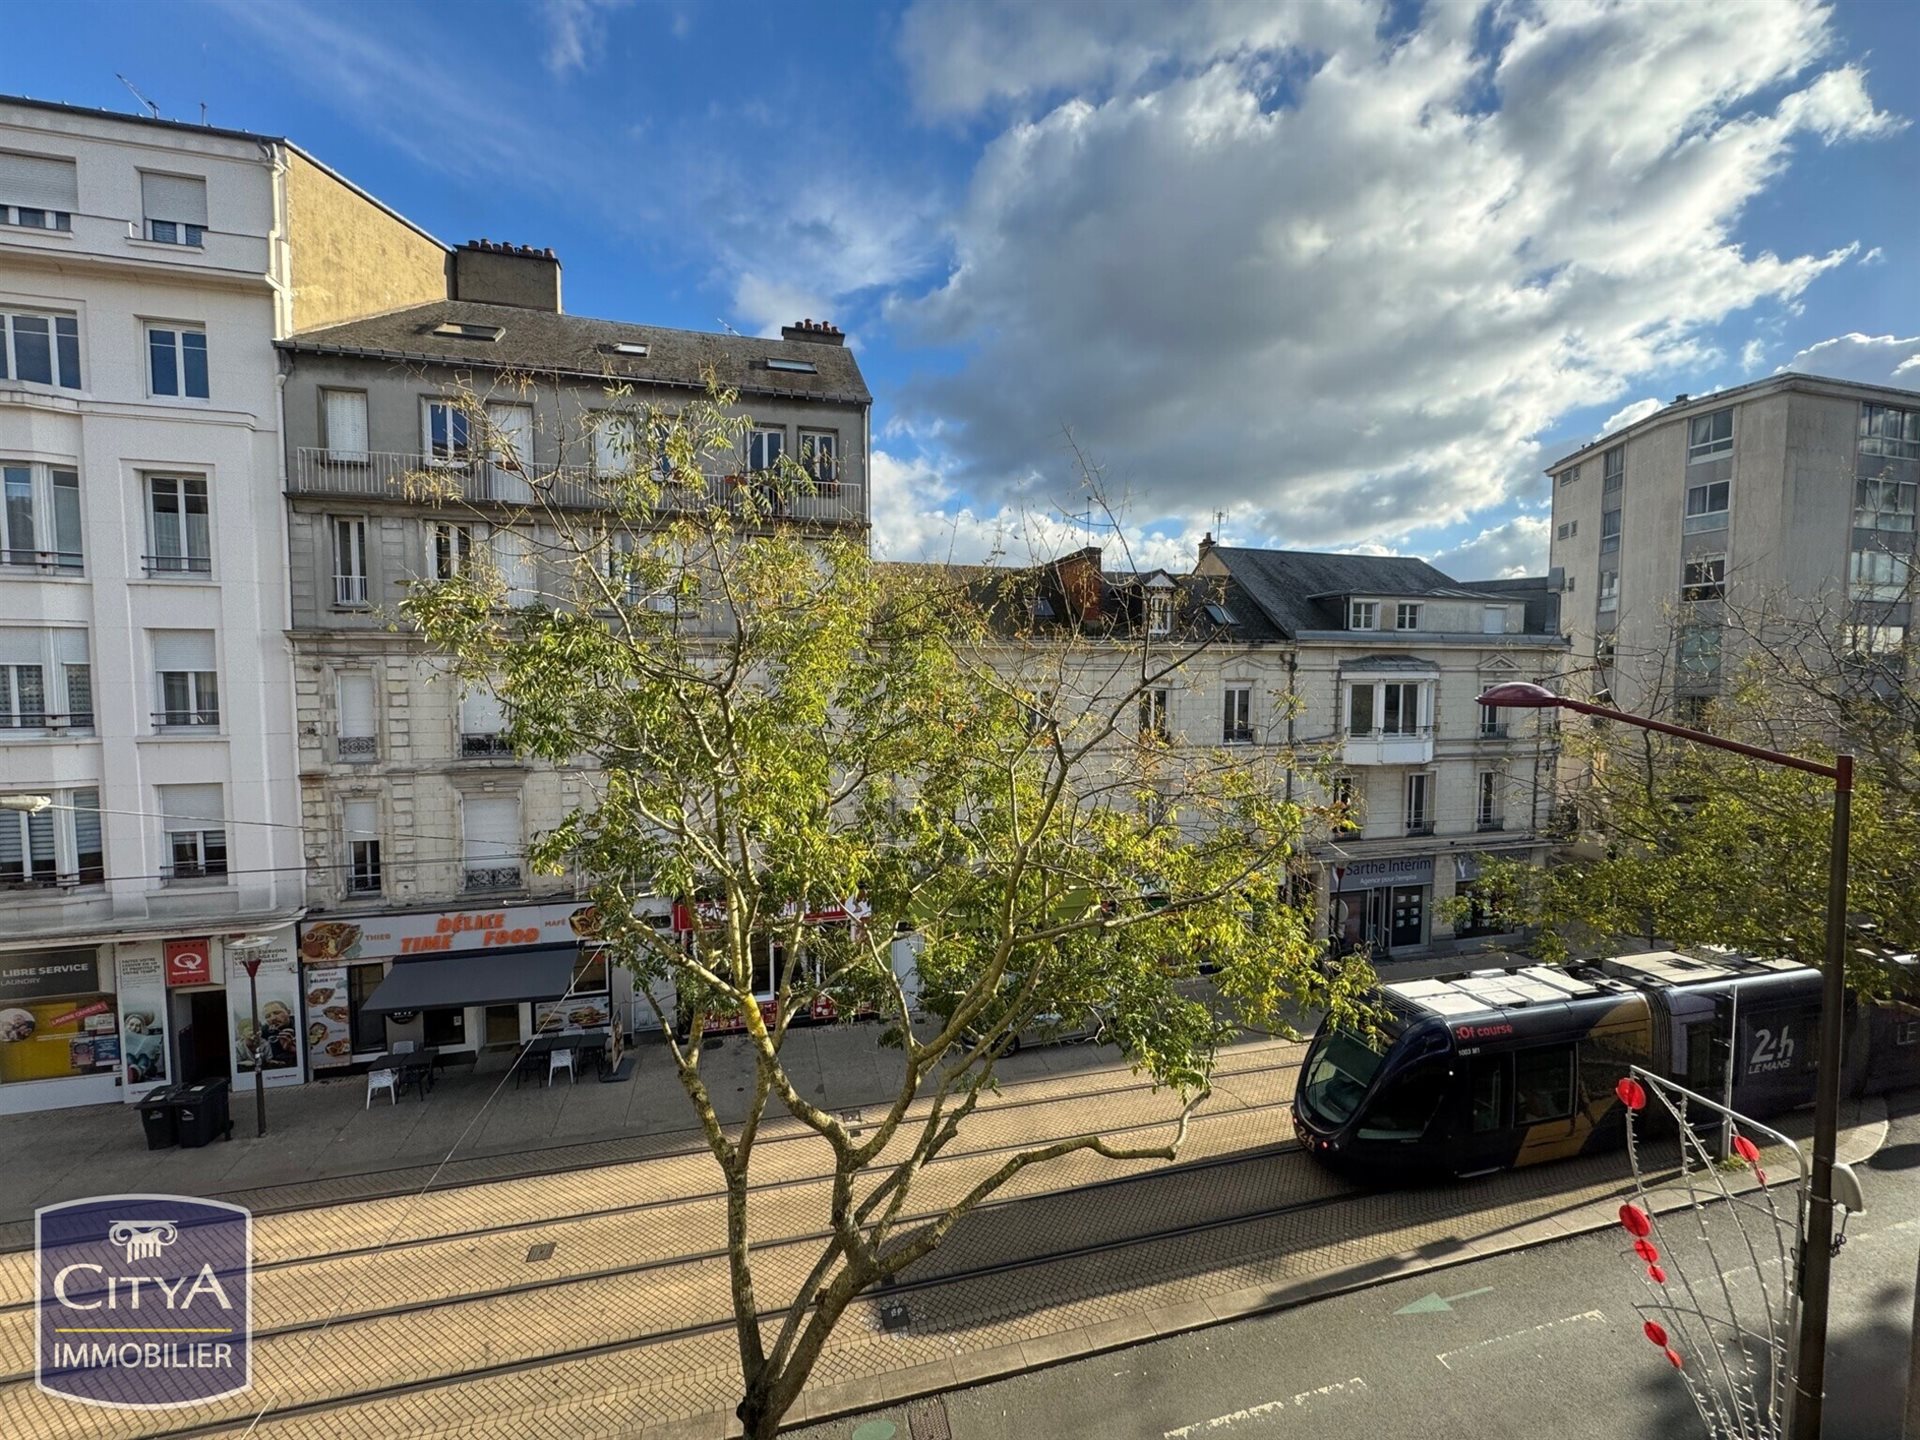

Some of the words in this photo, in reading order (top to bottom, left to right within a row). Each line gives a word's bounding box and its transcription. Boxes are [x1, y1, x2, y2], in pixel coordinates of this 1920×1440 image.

[1346, 862, 1386, 876] Sarthe
[436, 913, 505, 933] DÉLICE
[401, 933, 455, 953] TIME
[484, 928, 540, 946] FOOD
[3, 968, 36, 977] LIBRE
[38, 962, 89, 975] SERVICE
[0, 977, 41, 986] LAUNDRY
[1477, 1024, 1512, 1037] course
[1748, 1063, 1762, 1074] LE
[1762, 1059, 1791, 1072] MANS
